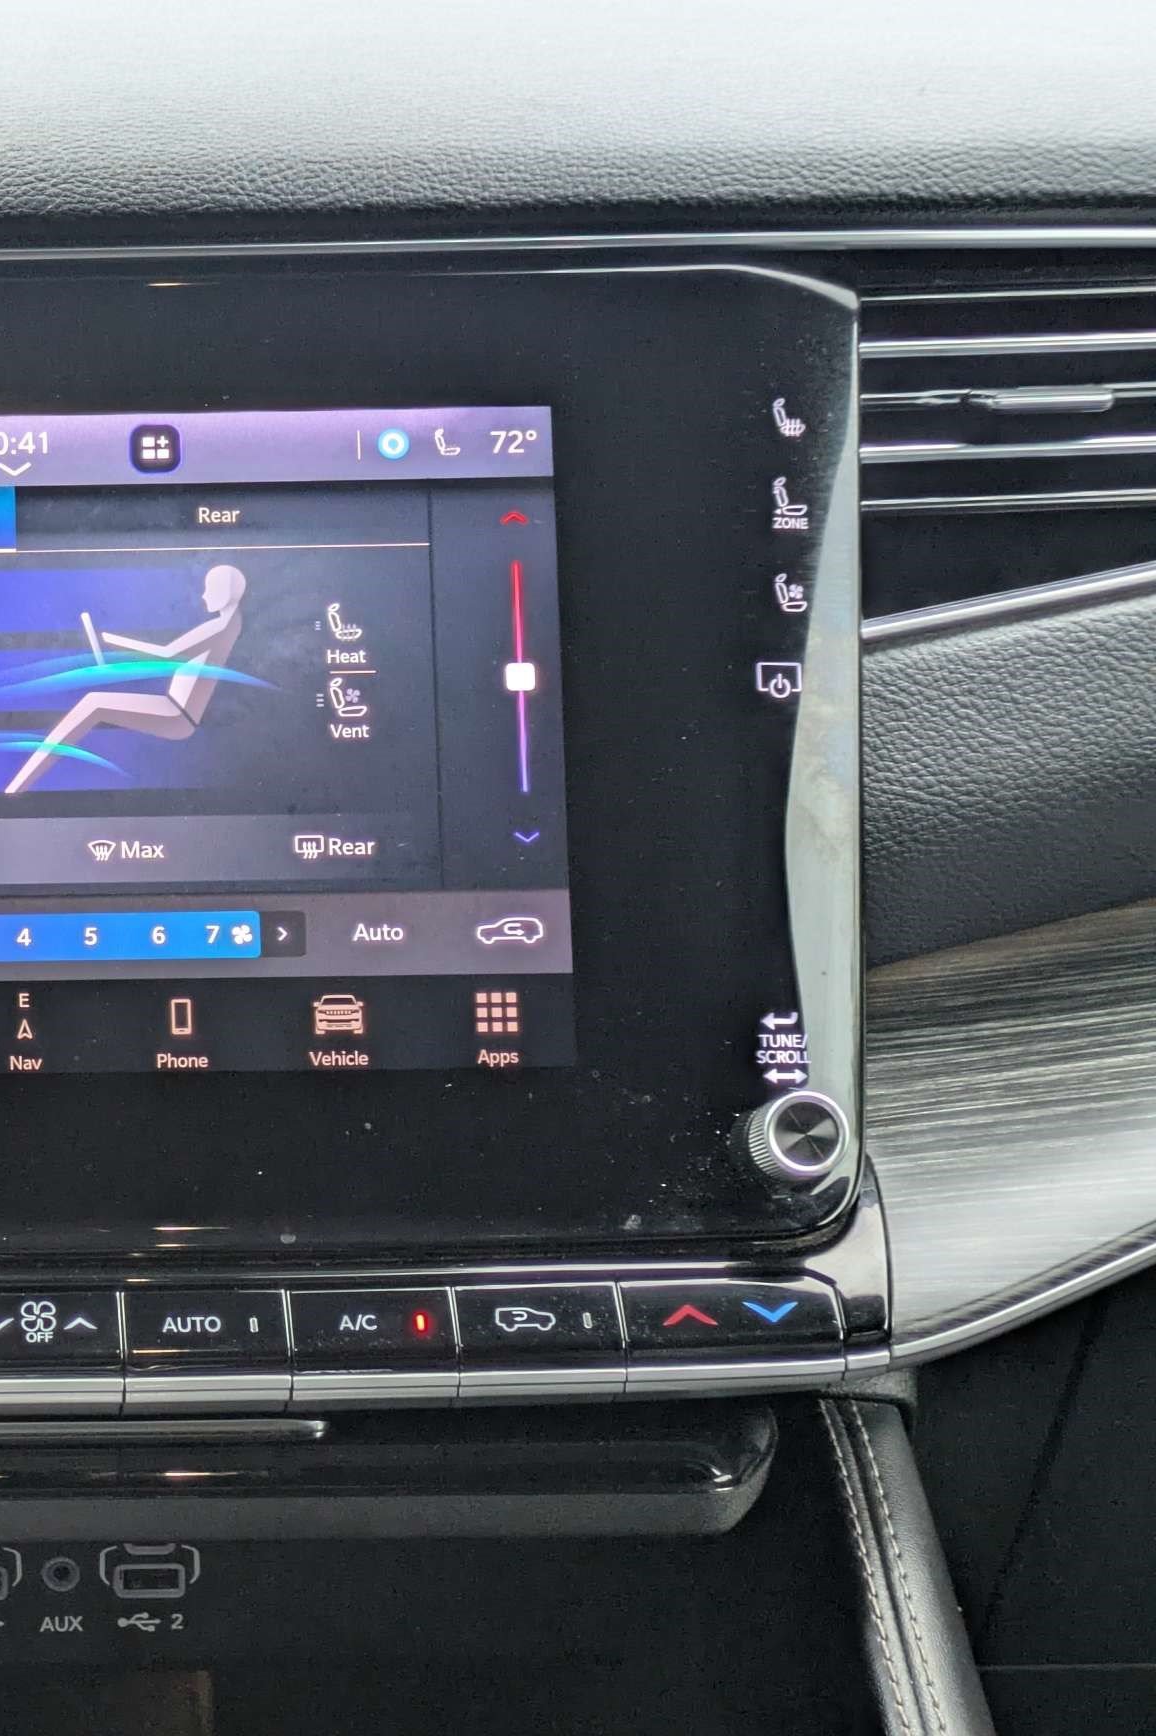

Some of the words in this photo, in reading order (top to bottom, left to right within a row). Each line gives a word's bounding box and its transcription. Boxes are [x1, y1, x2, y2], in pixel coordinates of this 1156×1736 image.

[490, 429, 538, 454] 72°
[198, 506, 241, 524] Rear
[773, 516, 809, 530] ZONE
[326, 649, 367, 664] Heat
[329, 723, 370, 739] Vent
[120, 840, 165, 859] Max
[328, 837, 376, 856] Rear
[16, 927, 32, 947] 4
[84, 927, 98, 946] 5
[151, 926, 166, 945] 6
[205, 924, 220, 944] 7
[352, 923, 404, 942] Auto
[18, 992, 30, 1008] E
[756, 1034, 809, 1049] TUNE/
[9, 1055, 43, 1071] Nav
[156, 1052, 209, 1069] Phone
[309, 1050, 369, 1067] Vehicle
[477, 1048, 519, 1068] Apps
[755, 1050, 812, 1065] SCROLL
[162, 1316, 222, 1333] AUTO
[339, 1313, 378, 1331] A/C
[23, 1327, 54, 1343] OFF
[39, 1615, 83, 1633] AUX
[171, 1613, 184, 1630] 2
